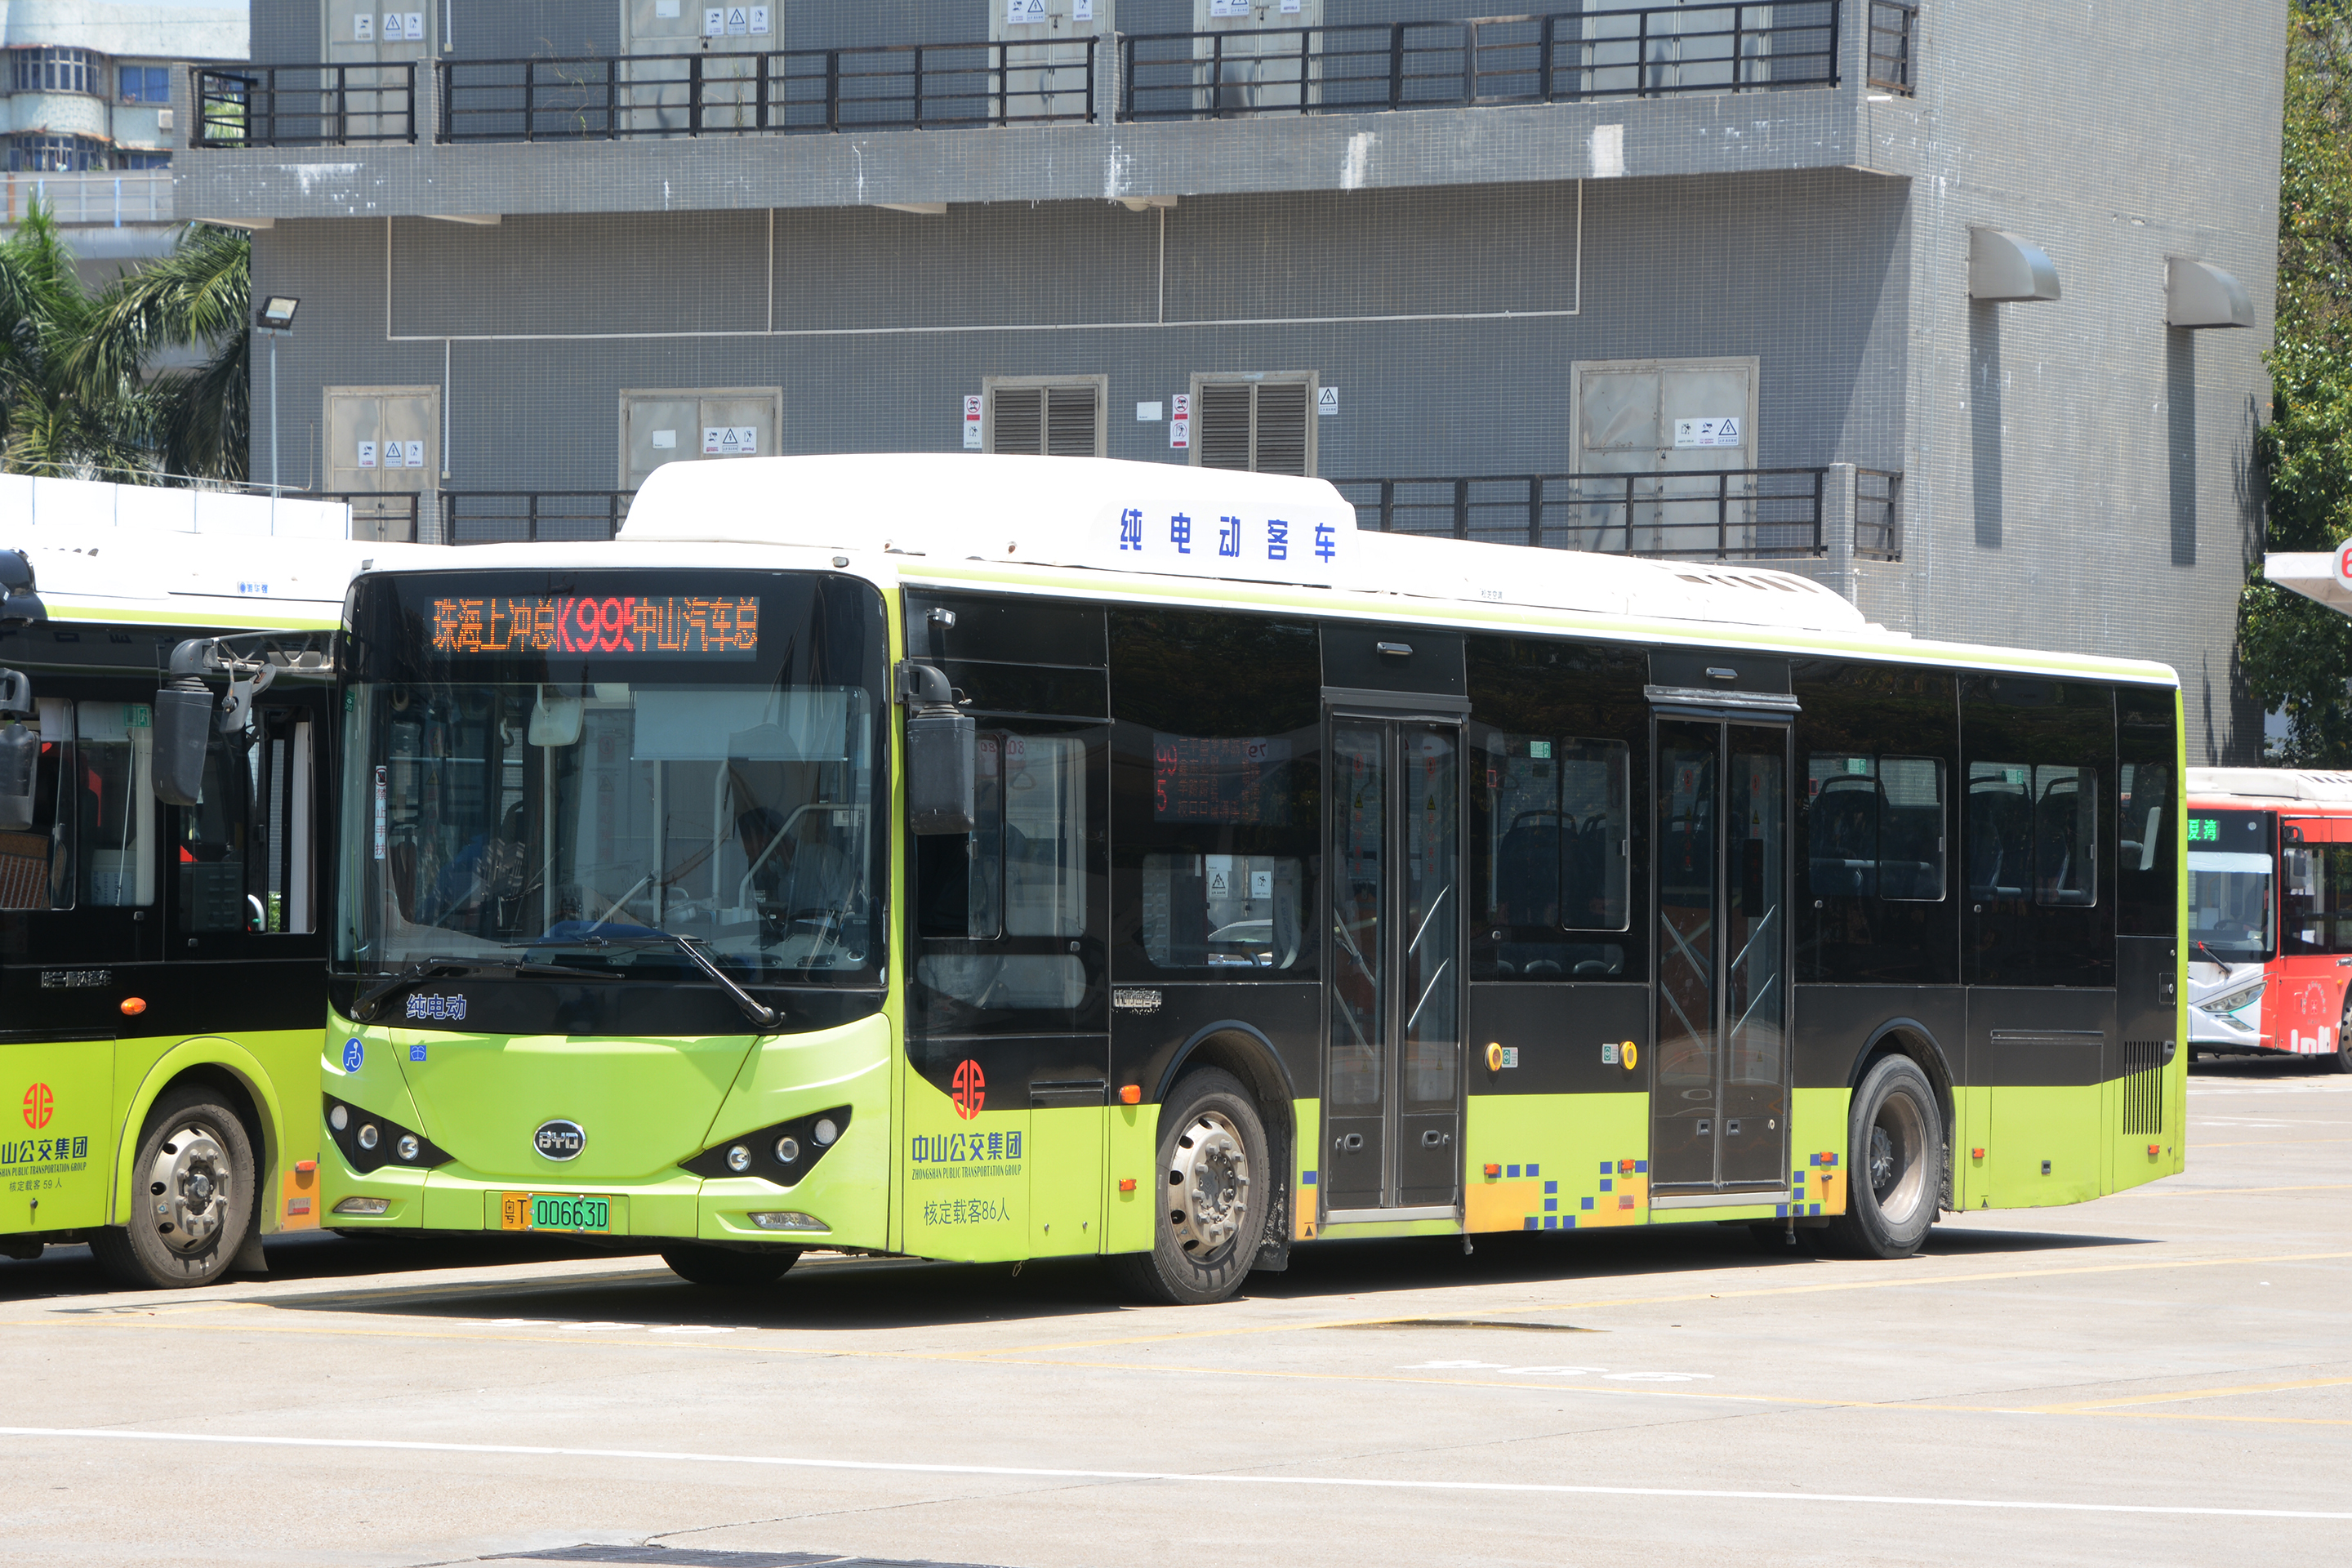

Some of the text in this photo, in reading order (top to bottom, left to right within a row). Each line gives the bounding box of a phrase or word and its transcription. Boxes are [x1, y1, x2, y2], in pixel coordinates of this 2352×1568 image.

[1120, 508, 1336, 564] 纯电动客车
[375, 787, 387, 856] 禁止手扶
[406, 993, 467, 1021] 纯电动
[2, 1136, 88, 1165] 山公交集团
[539, 1131, 579, 1149] BYD
[911, 1131, 1022, 1163] 中山公交集团
[12, 1165, 29, 1177] PUBLIC
[29, 1163, 70, 1176] TRANSPORTATION
[71, 1161, 87, 1172] GROUP
[911, 1164, 1022, 1181] ZHONGSHAN PUBLIC TRANSPORTATION GROUP
[924, 1197, 1010, 1227] 核定载客86人
